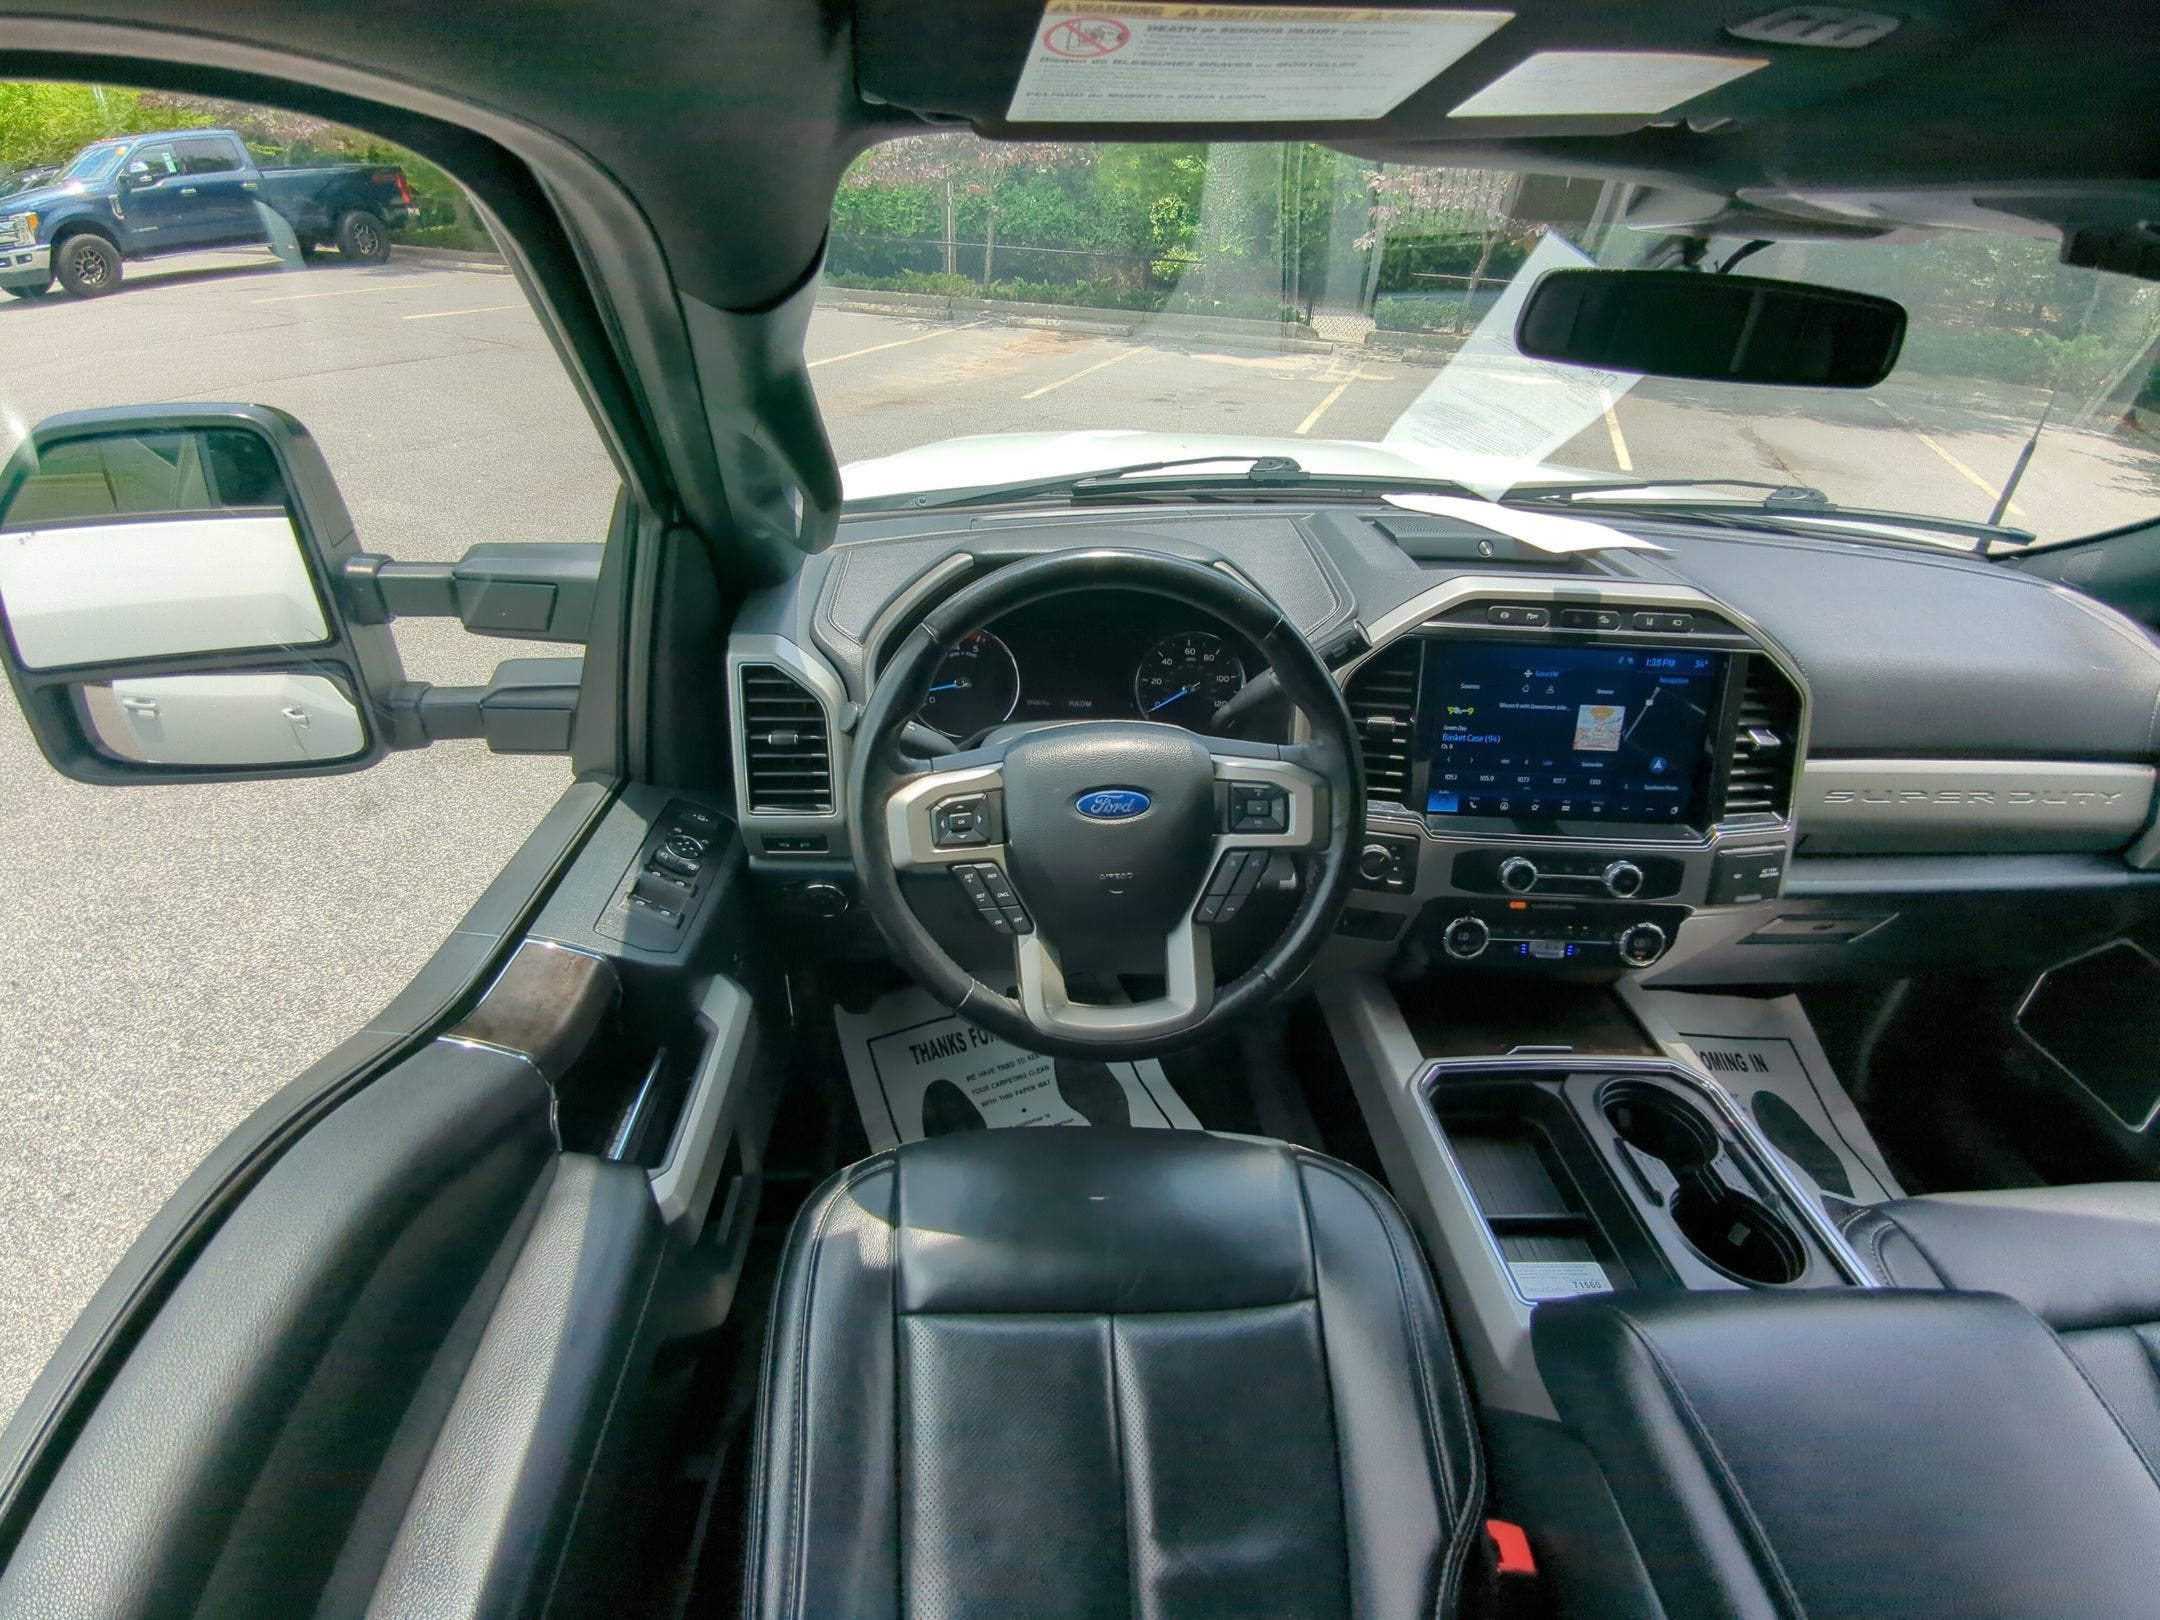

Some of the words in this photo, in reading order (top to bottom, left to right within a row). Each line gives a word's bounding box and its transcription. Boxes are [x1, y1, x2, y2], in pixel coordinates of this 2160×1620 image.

[1076, 3, 1164, 15] WARNING
[1147, 24, 1197, 33] DEATH
[1219, 27, 1283, 35] SERIOUS
[1184, 647, 1196, 656] 60
[1161, 658, 1173, 666] 40
[1203, 654, 1215, 662] 80
[1662, 658, 1676, 668] PM
[1150, 677, 1162, 686] 20
[1216, 674, 1230, 683] 100
[1442, 733, 1466, 742] Basket
[1467, 734, 1483, 743] Case
[1823, 789, 1995, 805] SUPER
[2008, 789, 2121, 805] DUTY
[1090, 794, 1135, 814] Ford
[909, 1031, 967, 1065] THANKS
[968, 1027, 994, 1048] FO
[979, 1068, 996, 1077] HAVE
[997, 1061, 1015, 1071] TRIED
[1016, 1057, 1026, 1065] TO
[1748, 1053, 1770, 1073] IN
[971, 1085, 990, 1096] YOUR
[991, 1071, 1027, 1089] CARPETING
[1029, 1065, 1050, 1077] CLEAN
[981, 1097, 998, 1108] WITH
[999, 1092, 1014, 1102] THIS
[1015, 1085, 1037, 1097] PAPER
[1037, 1079, 1051, 1088] MAT
